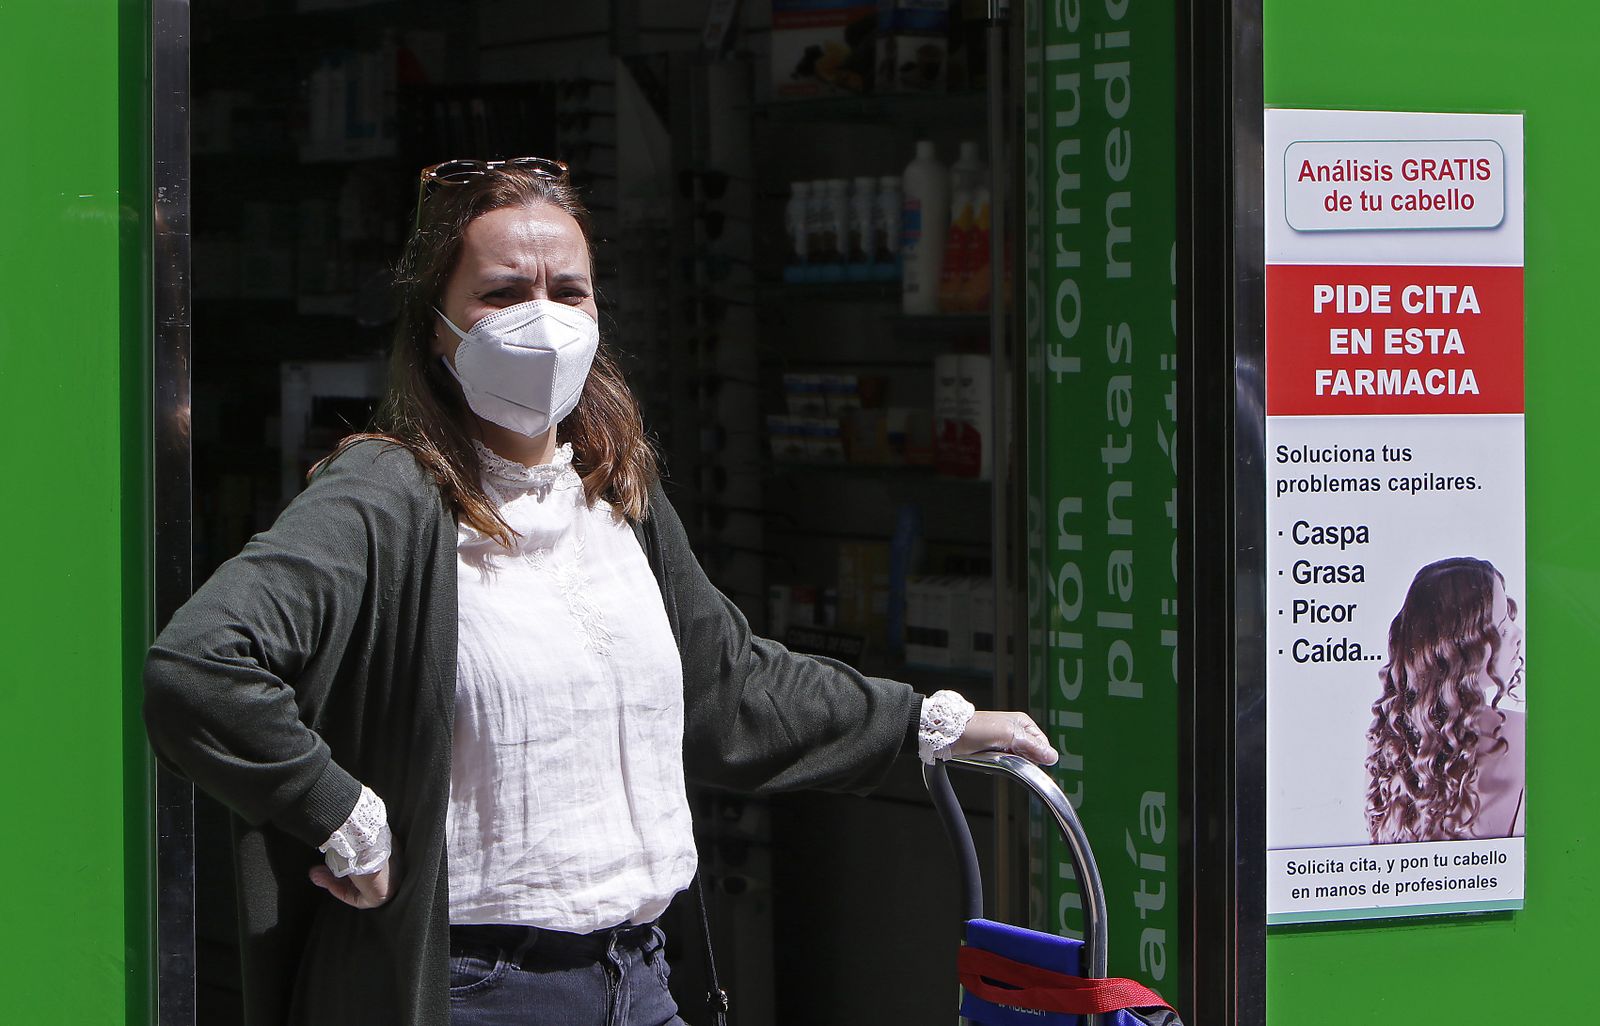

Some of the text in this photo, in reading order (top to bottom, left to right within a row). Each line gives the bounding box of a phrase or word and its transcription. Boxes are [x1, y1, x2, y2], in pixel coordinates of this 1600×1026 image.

[1298, 159, 1490, 182] Análisis GRATIS
[1325, 189, 1474, 211] de tu cabello
[1314, 285, 1480, 313] PIDE CITA
[1330, 328, 1465, 354] EN ESTA
[1316, 369, 1479, 395] FARMACIA
[1277, 445, 1412, 463] Soluciona tus
[1277, 473, 1481, 497] problemas capilares.
[1097, 322, 1143, 698] plantas
[1293, 521, 1369, 550] Caspa
[1293, 560, 1365, 584] Grasa
[1293, 599, 1357, 623] Picor
[1293, 638, 1381, 663] Caída...
[1287, 851, 1506, 875] Solicita cita, y pon tu cabello
[1292, 875, 1497, 899] en manos de profesionales
